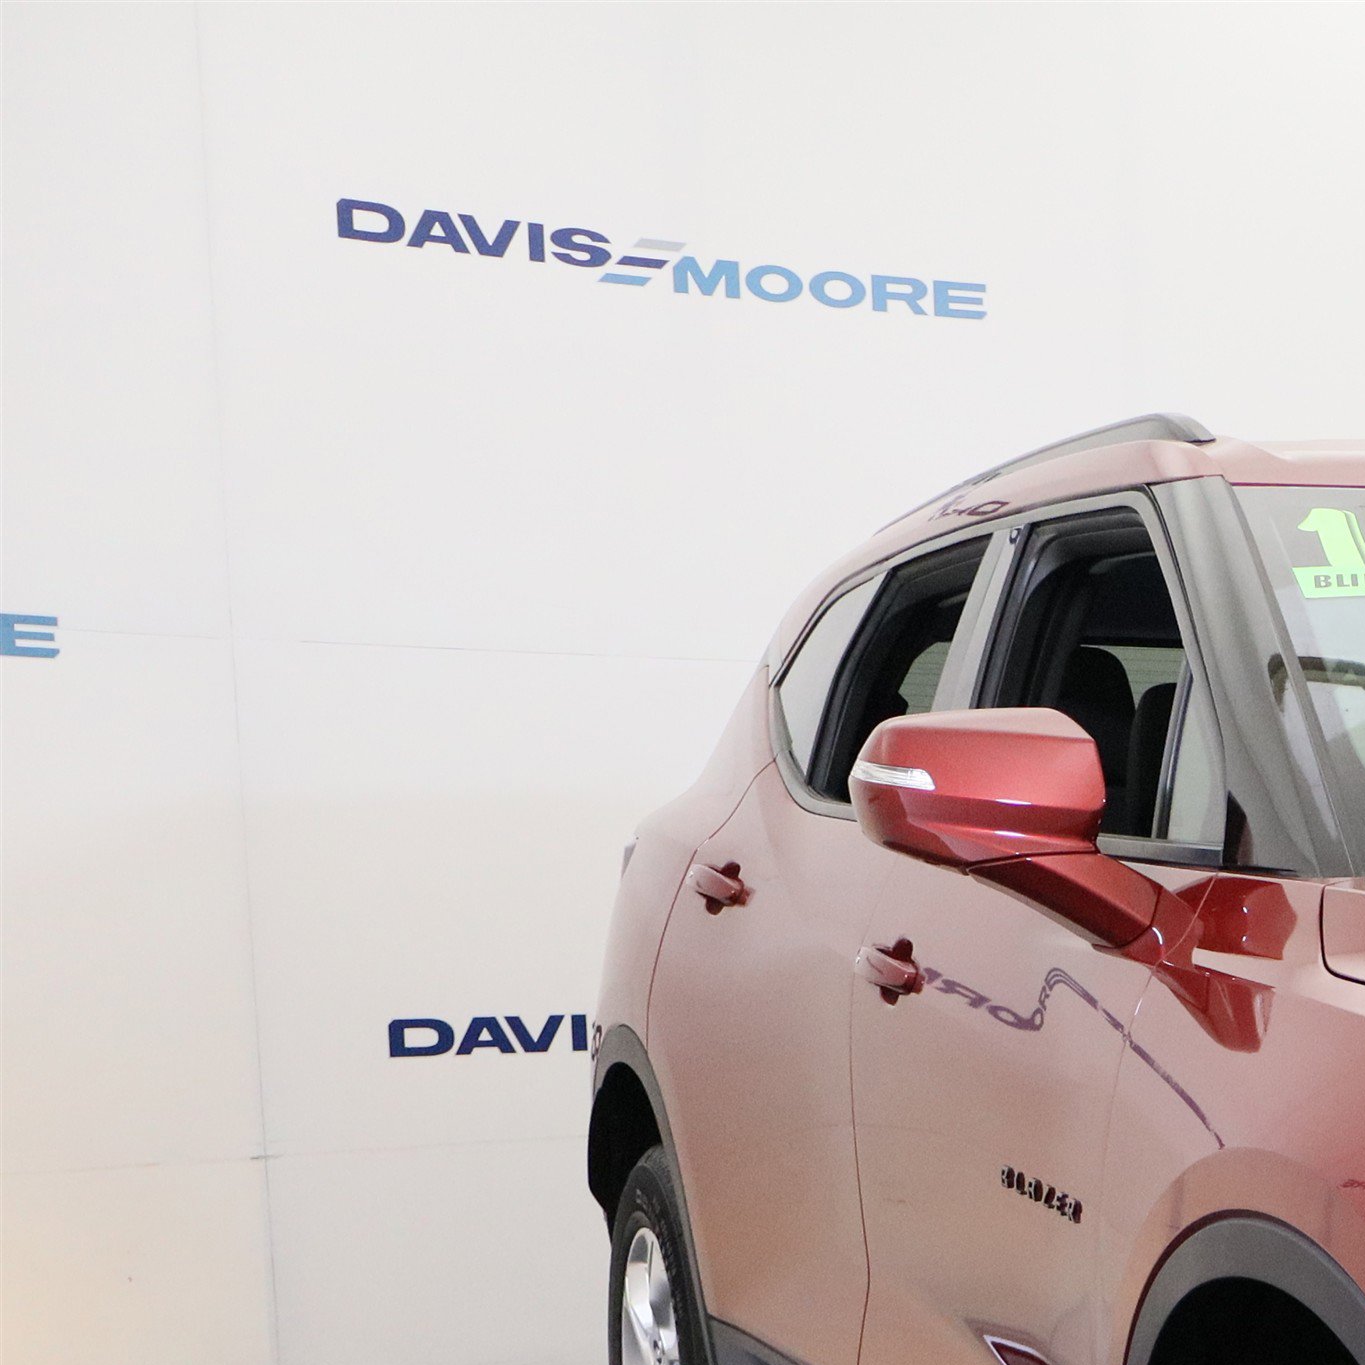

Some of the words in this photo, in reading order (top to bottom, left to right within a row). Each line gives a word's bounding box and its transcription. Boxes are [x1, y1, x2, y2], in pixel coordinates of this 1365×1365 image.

[335, 197, 612, 268] DAVIS
[672, 256, 987, 320] MOORE
[387, 1013, 594, 1058] DAVI
[1000, 1165, 1082, 1223] BLAZER
